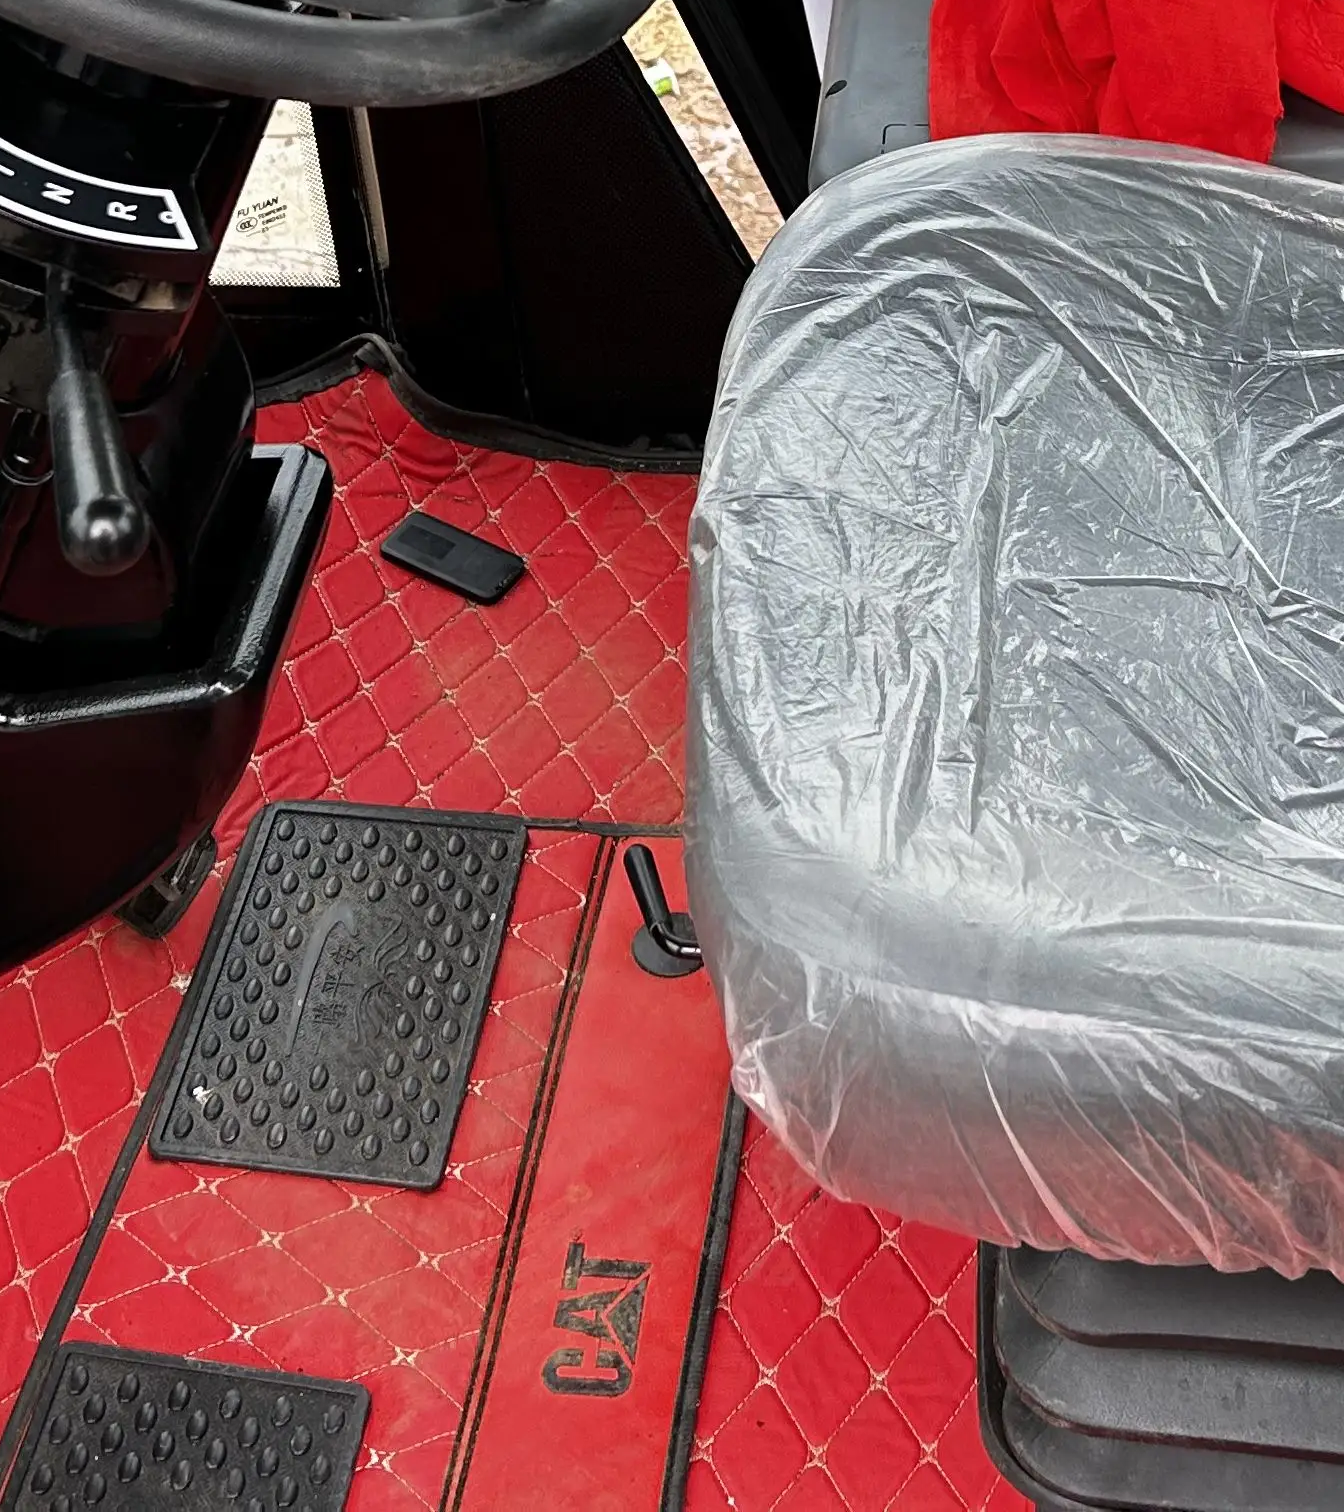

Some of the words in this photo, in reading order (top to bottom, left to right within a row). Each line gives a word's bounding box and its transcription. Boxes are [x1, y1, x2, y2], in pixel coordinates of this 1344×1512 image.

[41, 182, 75, 205] N
[106, 201, 138, 221] R
[237, 207, 250, 219] FU
[251, 196, 279, 212] YUAN
[540, 1241, 653, 1397] CAT
